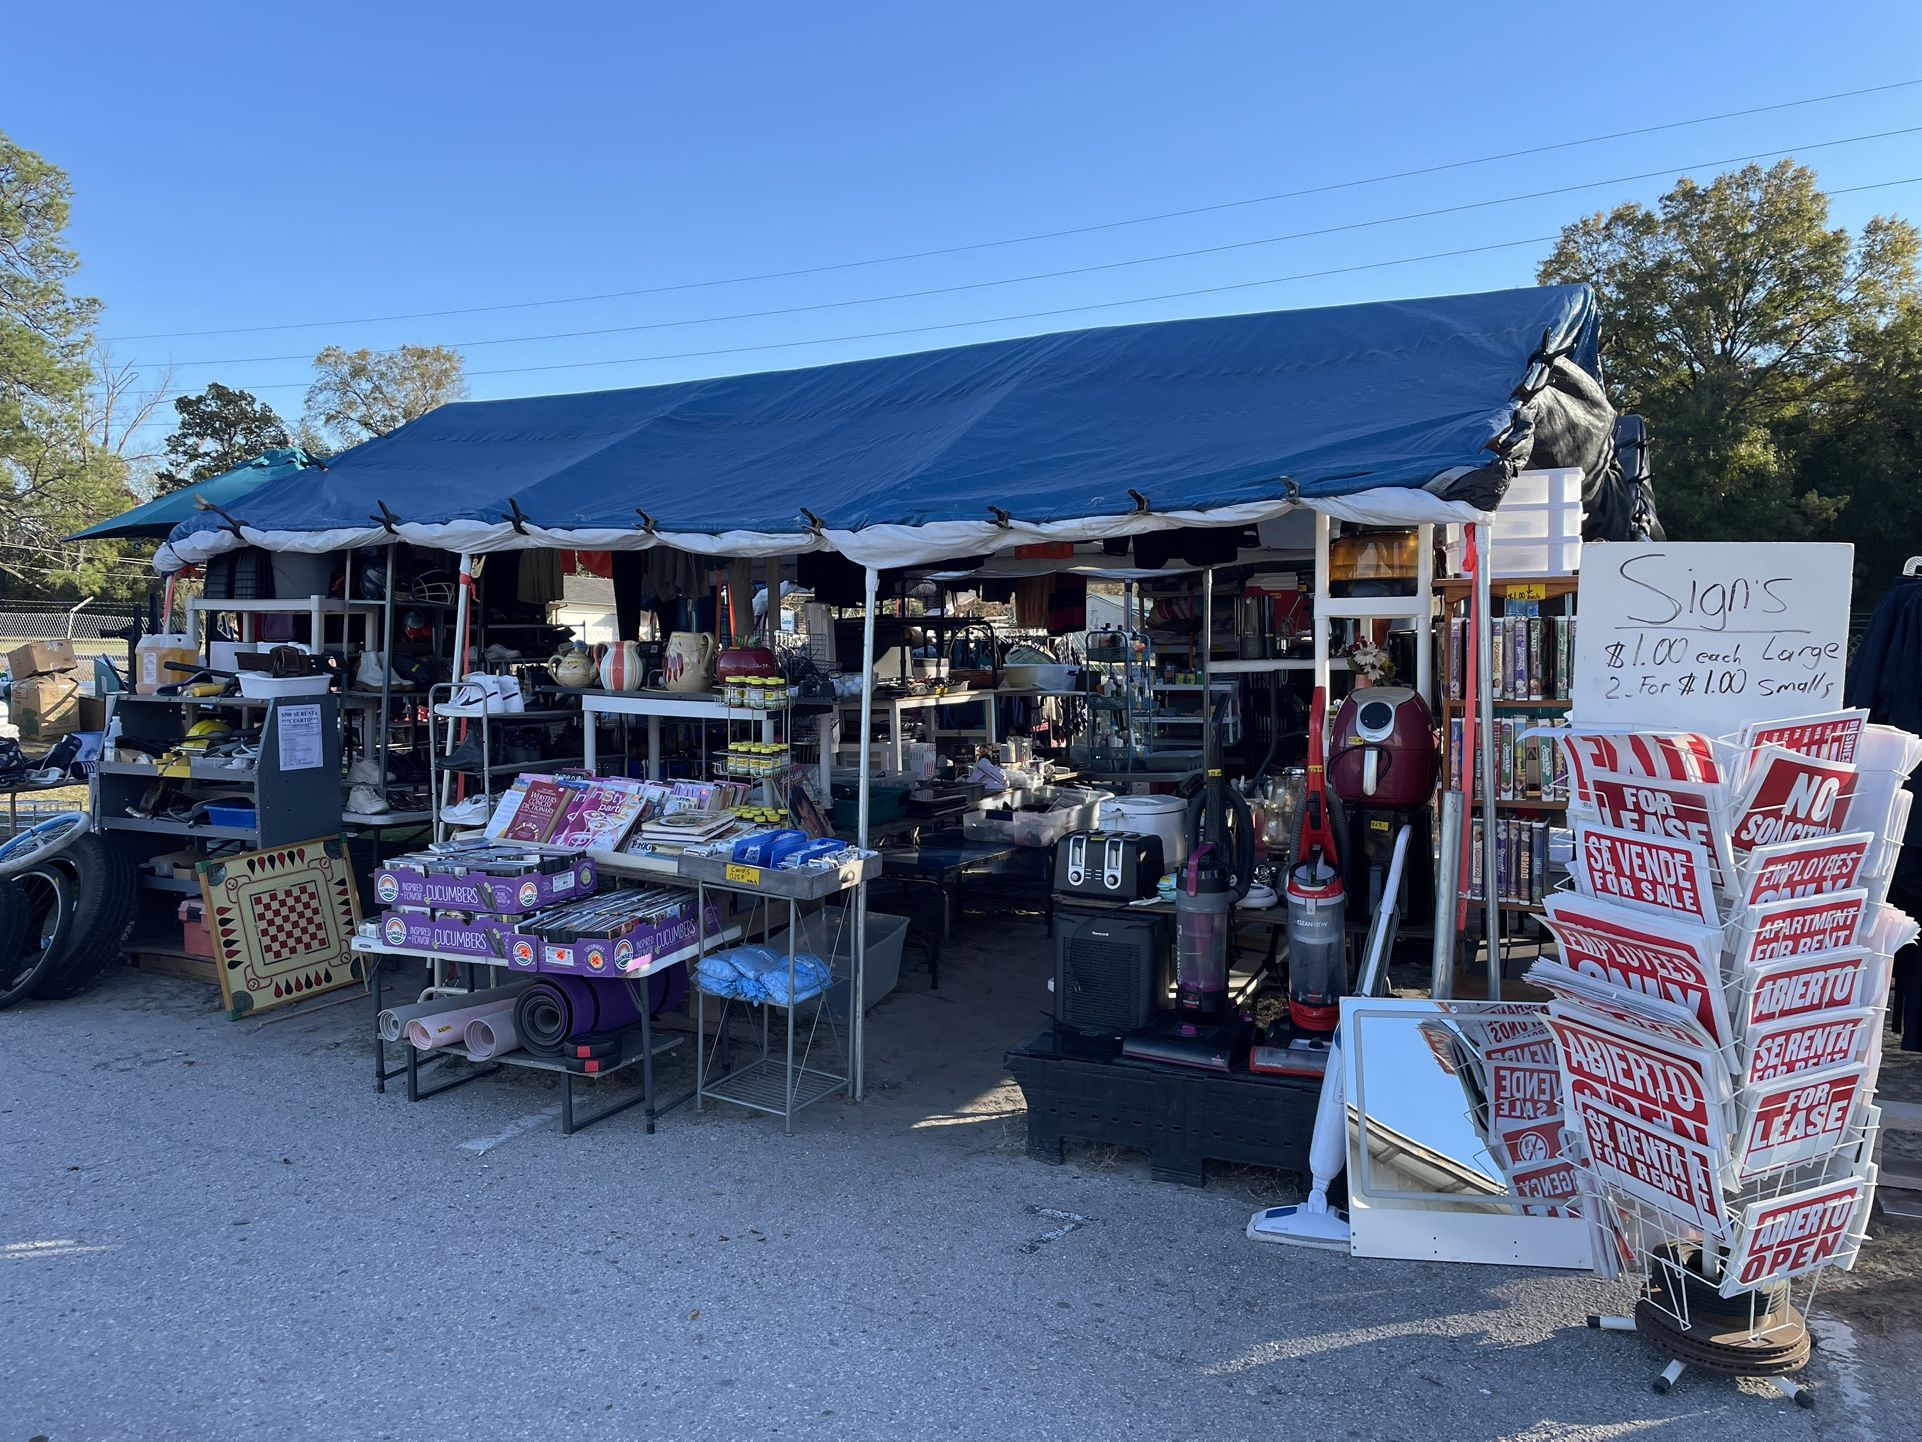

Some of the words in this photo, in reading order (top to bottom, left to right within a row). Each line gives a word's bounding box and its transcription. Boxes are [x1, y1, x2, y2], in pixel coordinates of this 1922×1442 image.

[1619, 553, 1793, 631] Sign's
[1605, 633, 1689, 669] $1.00
[1696, 644, 1742, 665] each
[1763, 636, 1840, 671] Large
[1639, 676, 1672, 697] For
[1678, 668, 1747, 697] $1.00
[1842, 719, 1861, 764] BUSINES
[590, 788, 629, 805] InSty
[1622, 786, 1676, 817] FOR
[1780, 772, 1841, 823] NO
[1739, 814, 1838, 845] SOLICIT
[1587, 835, 1617, 874] SE
[1615, 842, 1693, 890] VENDE
[1760, 851, 1855, 888] EMPLOYEES
[401, 882, 424, 894] INSPIRED
[426, 884, 479, 904] CUCUMBERS
[1592, 871, 1636, 897] FOR
[1640, 881, 1698, 912] SALE
[409, 926, 432, 937] INSPIRED
[434, 928, 488, 950] CUCUMBERS
[655, 918, 697, 949] CUCUMBERS
[1759, 906, 1860, 941] APARTMENT
[1562, 929, 1698, 984] EMPLOYEES
[1752, 965, 1856, 1019] ABIERTO
[1754, 1034, 1787, 1071] SE
[1783, 1022, 1856, 1063] RENTA
[1562, 1028, 1695, 1112] ABIERTO
[1786, 1083, 1831, 1113] FOR
[1750, 1099, 1849, 1151] LEASE
[1585, 1109, 1614, 1148] SE
[1616, 1121, 1688, 1183] RENTA
[1593, 1142, 1632, 1174] FOR
[1636, 1159, 1690, 1202] RENT
[1752, 1196, 1852, 1251] ABIERTO
[1739, 1231, 1842, 1285] OPEN
